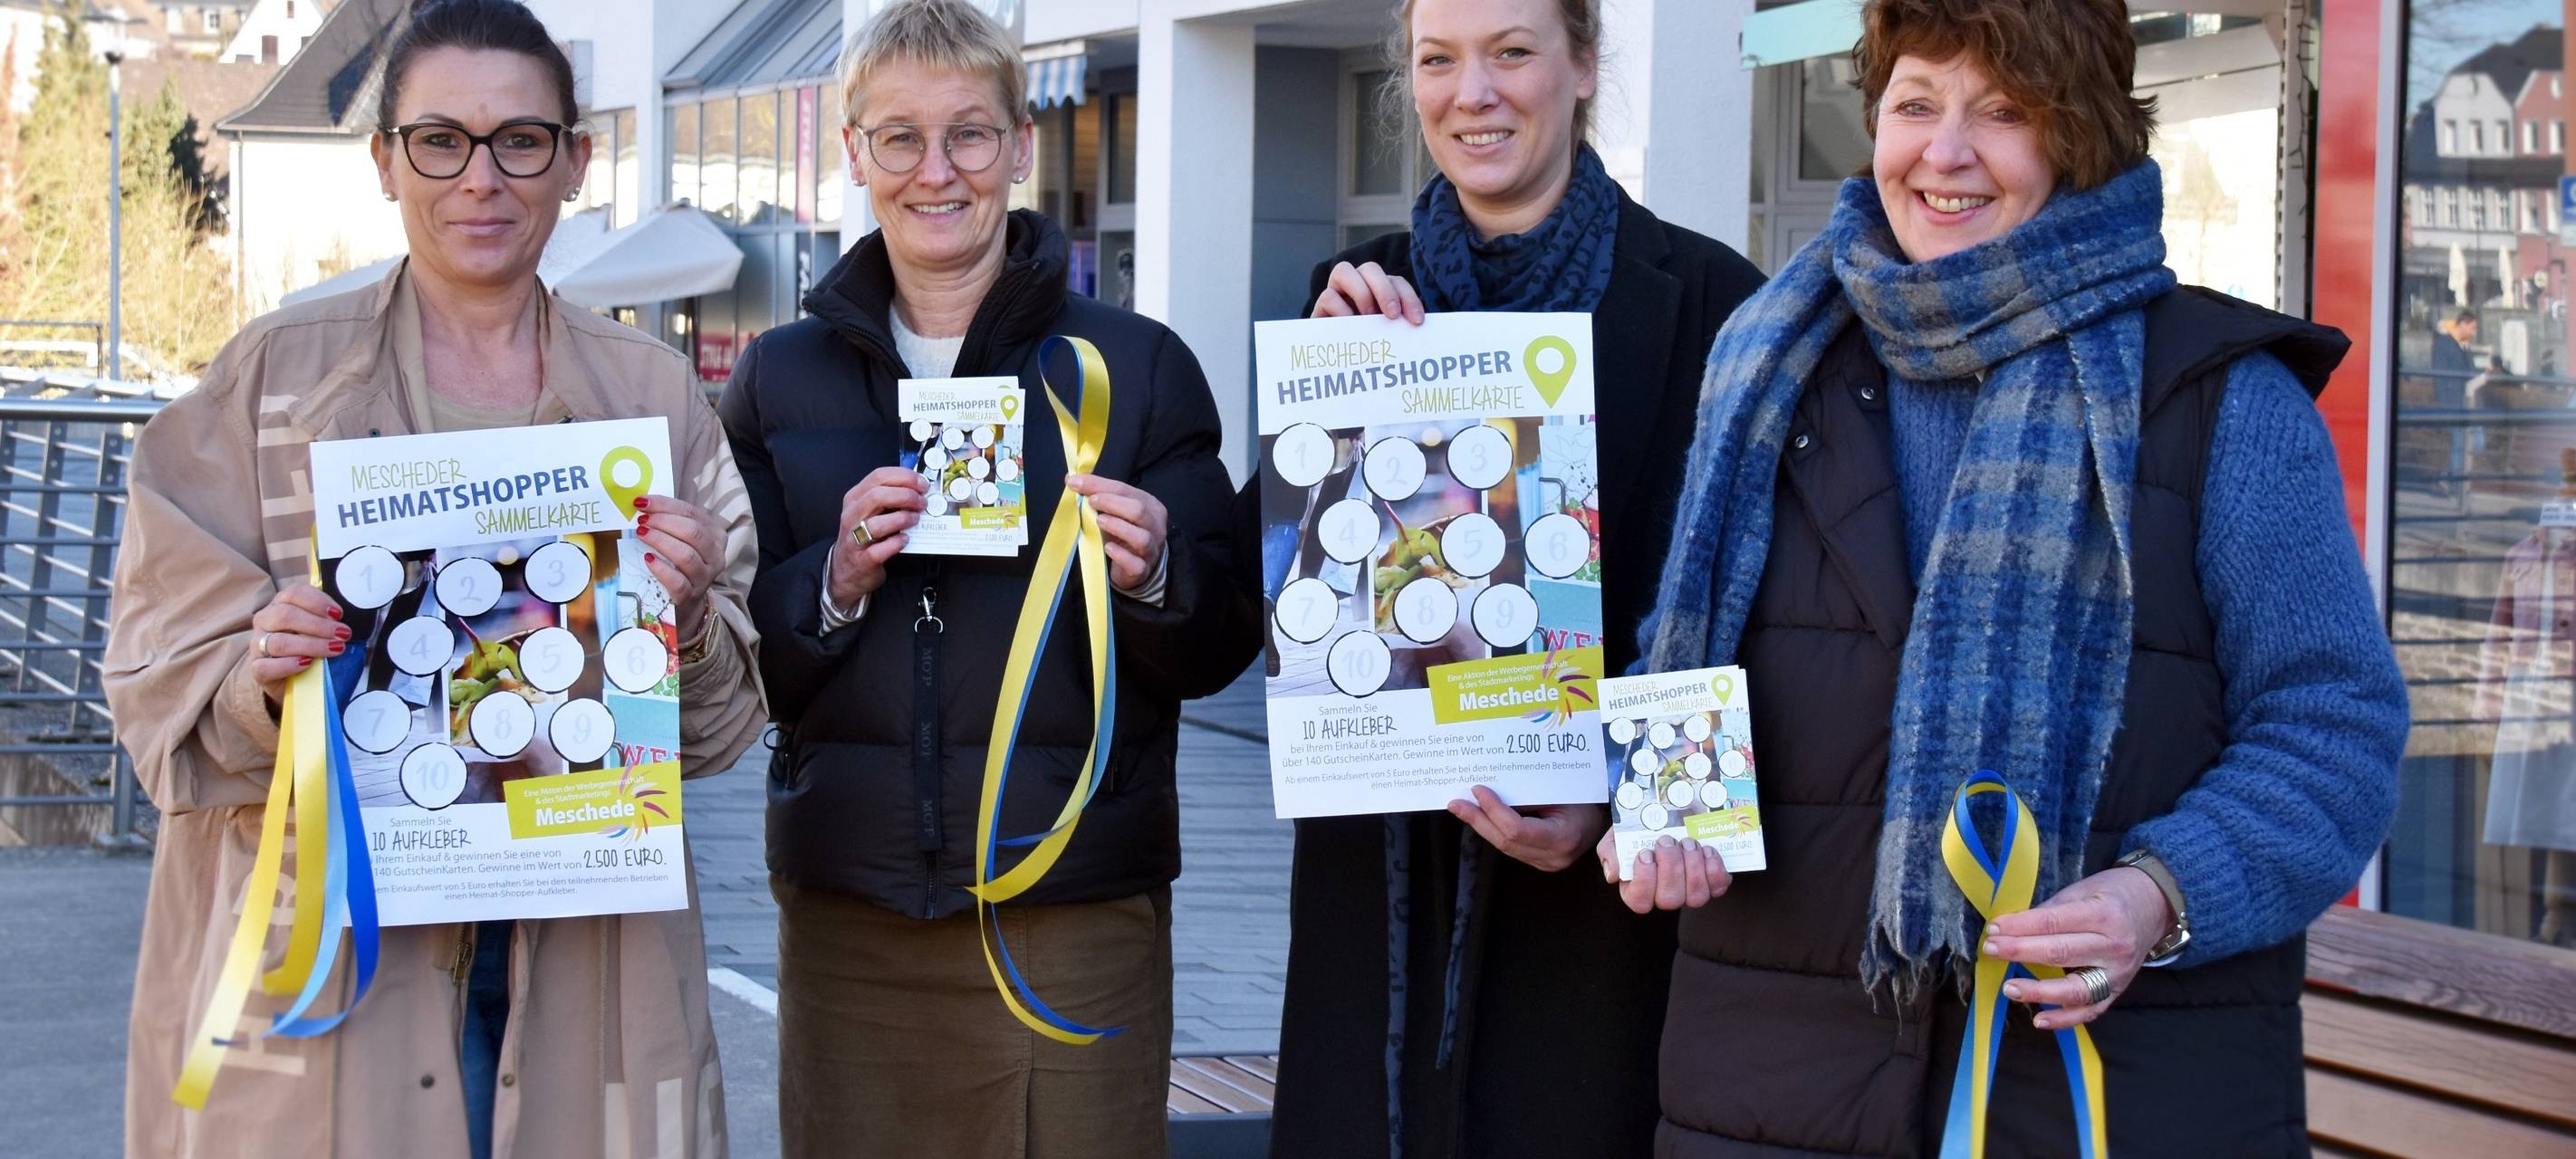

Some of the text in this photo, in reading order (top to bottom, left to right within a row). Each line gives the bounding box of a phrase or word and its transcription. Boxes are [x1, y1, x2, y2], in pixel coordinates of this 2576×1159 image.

[1291, 339, 1396, 371] MESCHEDER
[1277, 350, 1512, 405] HEIMATSHOPPER
[913, 399, 996, 412] HEIMATSHOPPER
[1401, 386, 1524, 414] SAMMELKARTE
[1294, 442, 1307, 470] 1
[1385, 455, 1407, 485] 2
[1469, 443, 1487, 473] 3
[351, 458, 466, 493] MESCHEDER
[338, 465, 590, 528] HEIMATSHOPPER
[475, 502, 602, 535] SAMMELKARTE
[1338, 517, 1358, 547] 4
[1463, 529, 1483, 559] 5
[1548, 532, 1568, 561] 6
[359, 564, 373, 593] 1
[547, 559, 566, 589] 3
[459, 575, 483, 604] 2
[1298, 597, 1315, 627] 7
[1418, 594, 1435, 626] 8
[1495, 599, 1514, 629] 9
[409, 633, 430, 660] 4
[1547, 628, 1603, 651] WE
[541, 644, 562, 674] 5
[626, 645, 646, 675] 6
[1341, 648, 1374, 679] 10
[1447, 660, 1569, 683] Eine Aktion der Werbegemeinschaft
[1465, 681, 1477, 689] des
[1479, 674, 1535, 687] Stadtmarketings
[1319, 703, 1378, 716] Sammeln Sie
[1459, 684, 1559, 711] Meschede
[1609, 682, 1707, 710] HEIMATSHOPPER
[367, 707, 386, 738] 7
[494, 709, 512, 740] 8
[572, 714, 591, 744] 9
[1302, 714, 1398, 740] 10 AUFKLEBER
[621, 743, 680, 766] WE
[1282, 746, 1504, 768] über 140 GutscheinKarten. Gewinne im Wert von
[1290, 734, 1485, 753] bei Ihrem Einkauf & gewinnen Sie eine von
[1506, 733, 1591, 753] 2.500 EURO.
[416, 761, 449, 791] 10
[524, 776, 644, 798] Eine Aktion der Werbegemeinschaft
[1284, 776, 1296, 785] Ab
[1297, 775, 1321, 784] einem
[1322, 771, 1370, 781] Einkaufswert
[1387, 770, 1392, 778] 5
[1393, 770, 1410, 778] Euro
[1412, 767, 1444, 776] erhalten
[1445, 765, 1457, 773] Sie
[1459, 764, 1471, 773] bei
[1473, 763, 1488, 772] den
[1490, 761, 1551, 771] teilnehmenden
[1552, 761, 1591, 770] Betrieben
[1371, 775, 1499, 790] einen Heimat-Shopper-Aufkleber.
[555, 790, 610, 802] Stadtmarketings
[390, 816, 451, 828] Sammeln Sie
[536, 799, 634, 826] Meschede
[372, 829, 471, 851] 10 AUFKLEBER
[1698, 820, 1739, 835] Meschede
[374, 860, 582, 876] 140 GutscheinKarten. Gewinne im Wert von
[376, 854, 404, 864] Ihrem
[407, 852, 441, 863] Einkauf
[444, 852, 451, 861] &
[454, 850, 501, 863] gewinnen
[504, 849, 517, 859] Sie
[543, 849, 562, 857] von
[583, 847, 667, 868] 2.500 EURO.
[391, 883, 442, 893] Einkaufswert
[444, 883, 459, 891] von
[461, 882, 466, 890] 5
[467, 881, 485, 889] Euro
[488, 878, 521, 888] erhalten
[523, 877, 534, 886] Sie
[536, 877, 549, 886] bei
[551, 876, 566, 886] den
[568, 874, 628, 885] teilnehmenden
[630, 873, 668, 883] Betrieben
[444, 886, 578, 900] einen Heimat-Shopper-Aufkleber.
